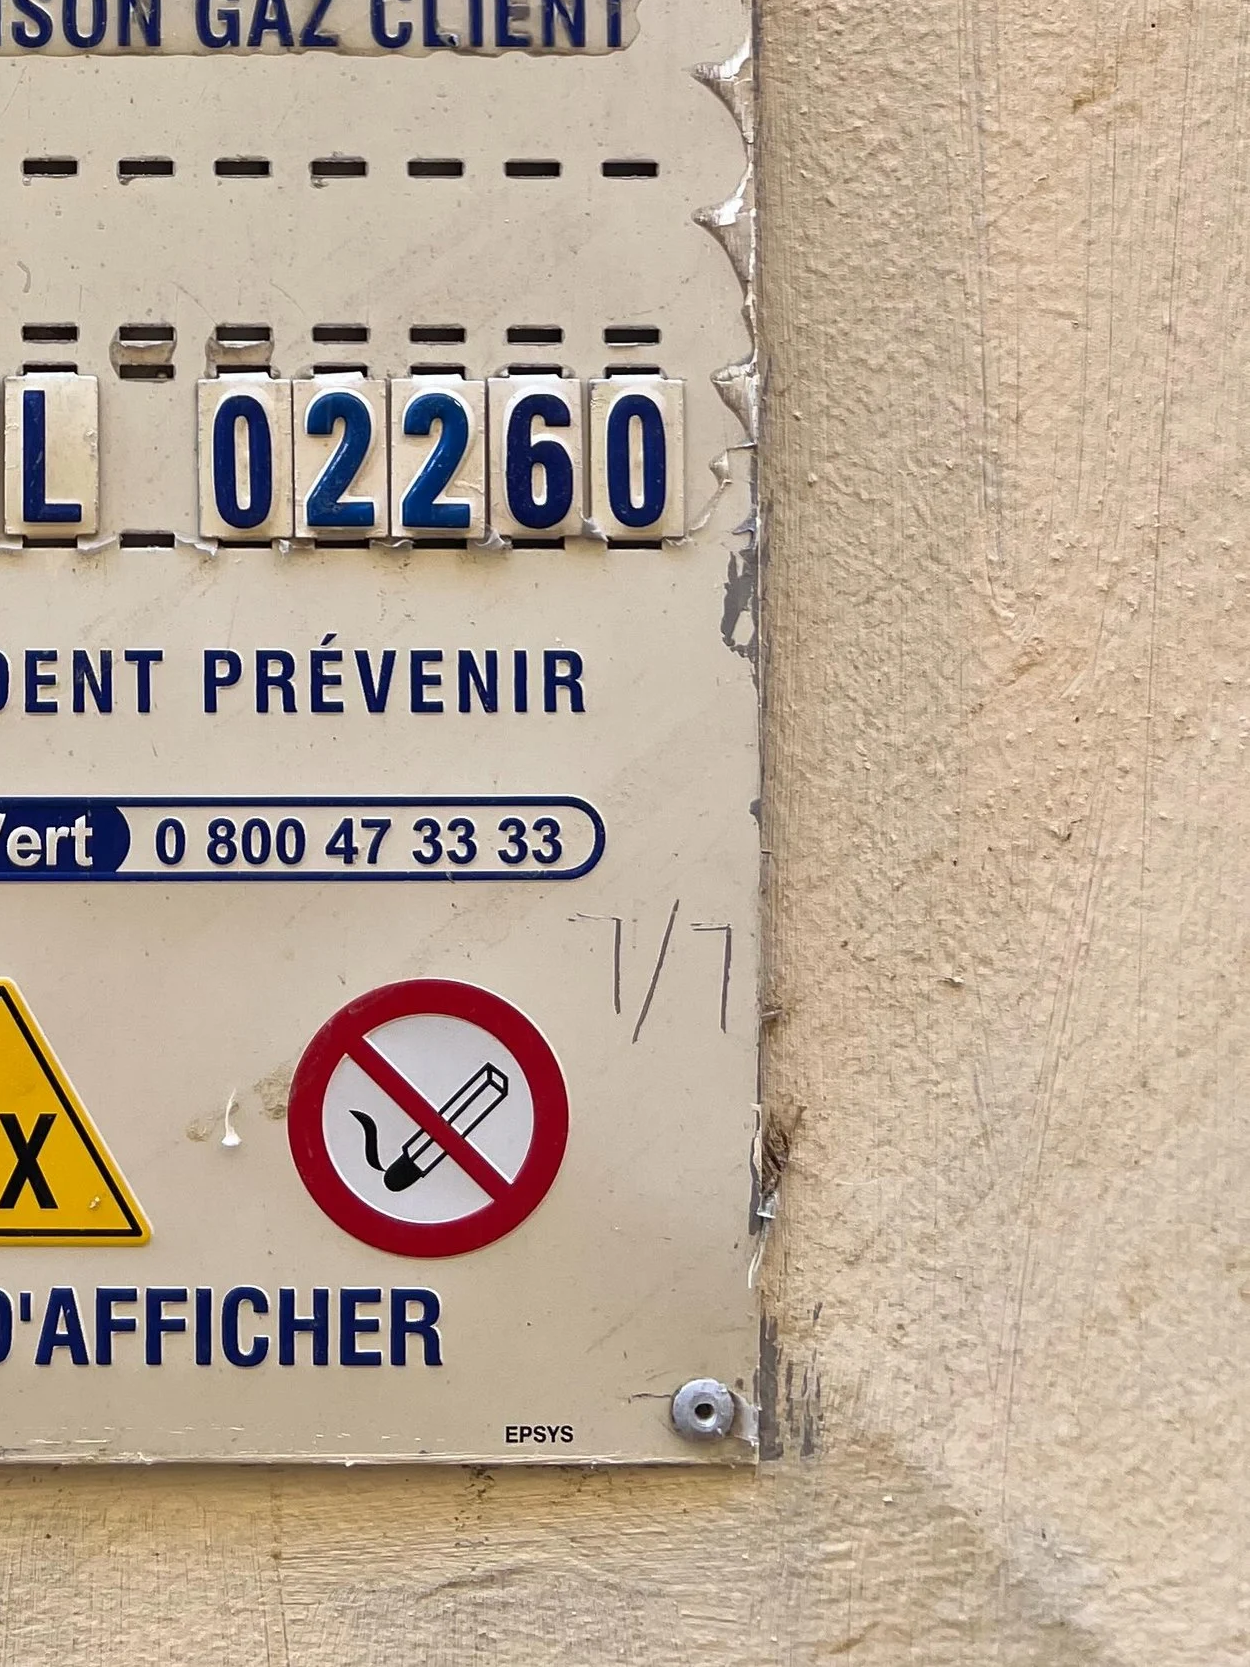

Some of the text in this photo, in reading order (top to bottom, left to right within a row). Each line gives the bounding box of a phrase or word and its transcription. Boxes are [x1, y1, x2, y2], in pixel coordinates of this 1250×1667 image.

[211, 390, 667, 530] 02260
[202, 632, 588, 716] PRÉVENIR
[154, 817, 187, 867] 0
[205, 817, 307, 867] 800
[324, 817, 393, 867] 47
[411, 817, 479, 867] 33
[496, 817, 564, 867] 33
[504, 1424, 574, 1444] EPSYS
